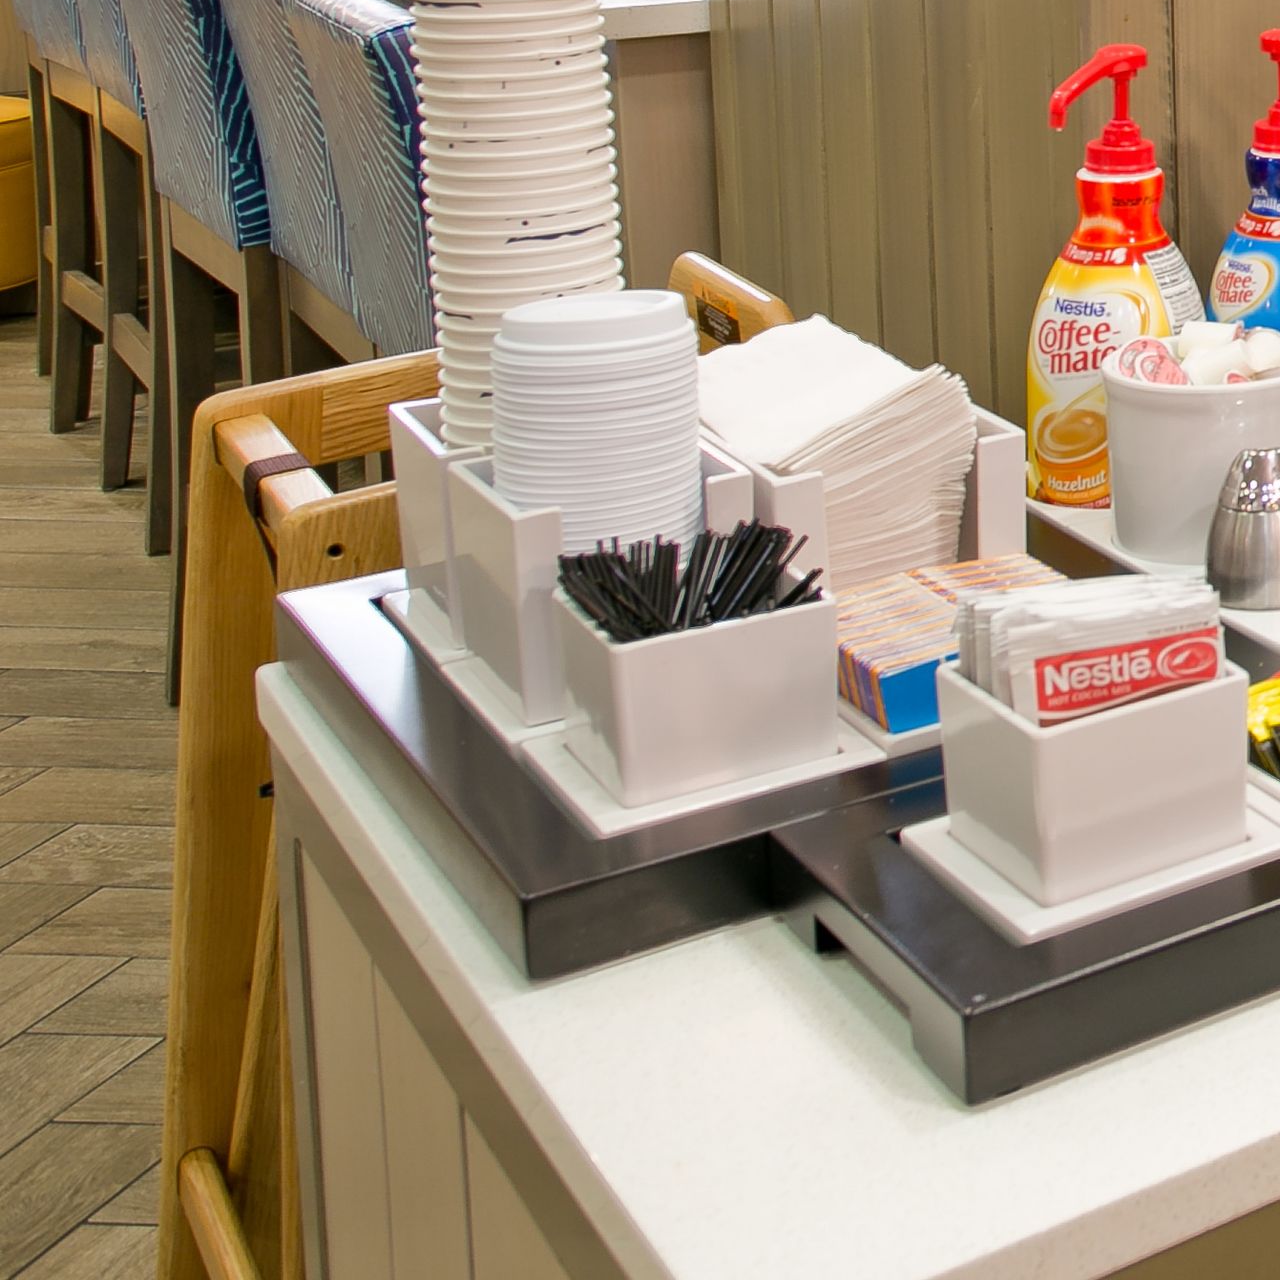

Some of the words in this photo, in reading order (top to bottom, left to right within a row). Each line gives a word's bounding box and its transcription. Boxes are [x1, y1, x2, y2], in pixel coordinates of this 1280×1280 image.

[1218, 289, 1253, 303] mate
[1047, 470, 1106, 492] Hazelnut
[1044, 647, 1152, 696] Nestlé
[1048, 696, 1070, 708] HOT
[1071, 689, 1109, 703] COCOA
[1111, 684, 1132, 696] MIX
